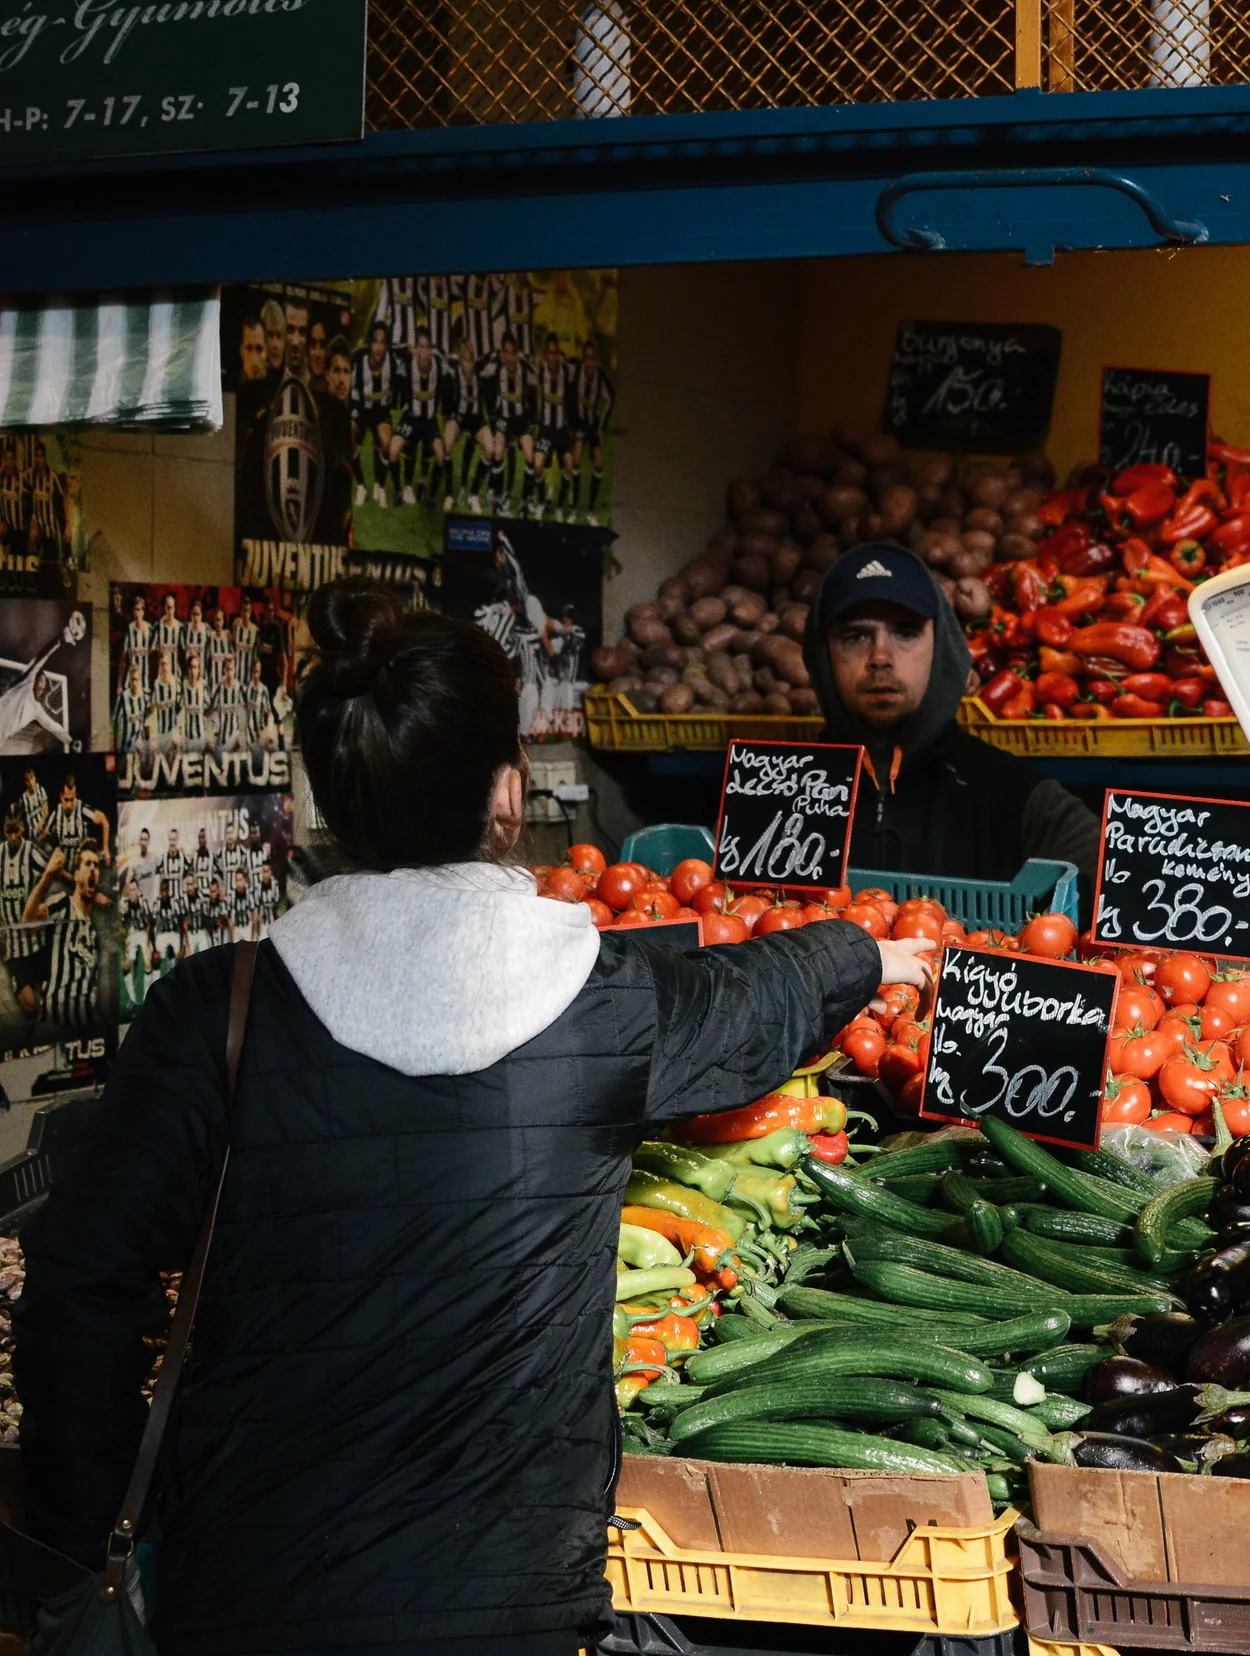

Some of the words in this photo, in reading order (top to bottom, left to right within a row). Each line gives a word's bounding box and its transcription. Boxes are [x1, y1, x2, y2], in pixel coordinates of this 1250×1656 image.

[63, 94, 148, 128] 7-17,
[225, 82, 300, 117] 7-13
[117, 751, 290, 791] JUVENTUS
[730, 744, 813, 779] Magyar
[1107, 793, 1211, 836] Magyar
[719, 815, 740, 872] kg
[1097, 894, 1122, 938] kg
[929, 1056, 955, 1105] kg
